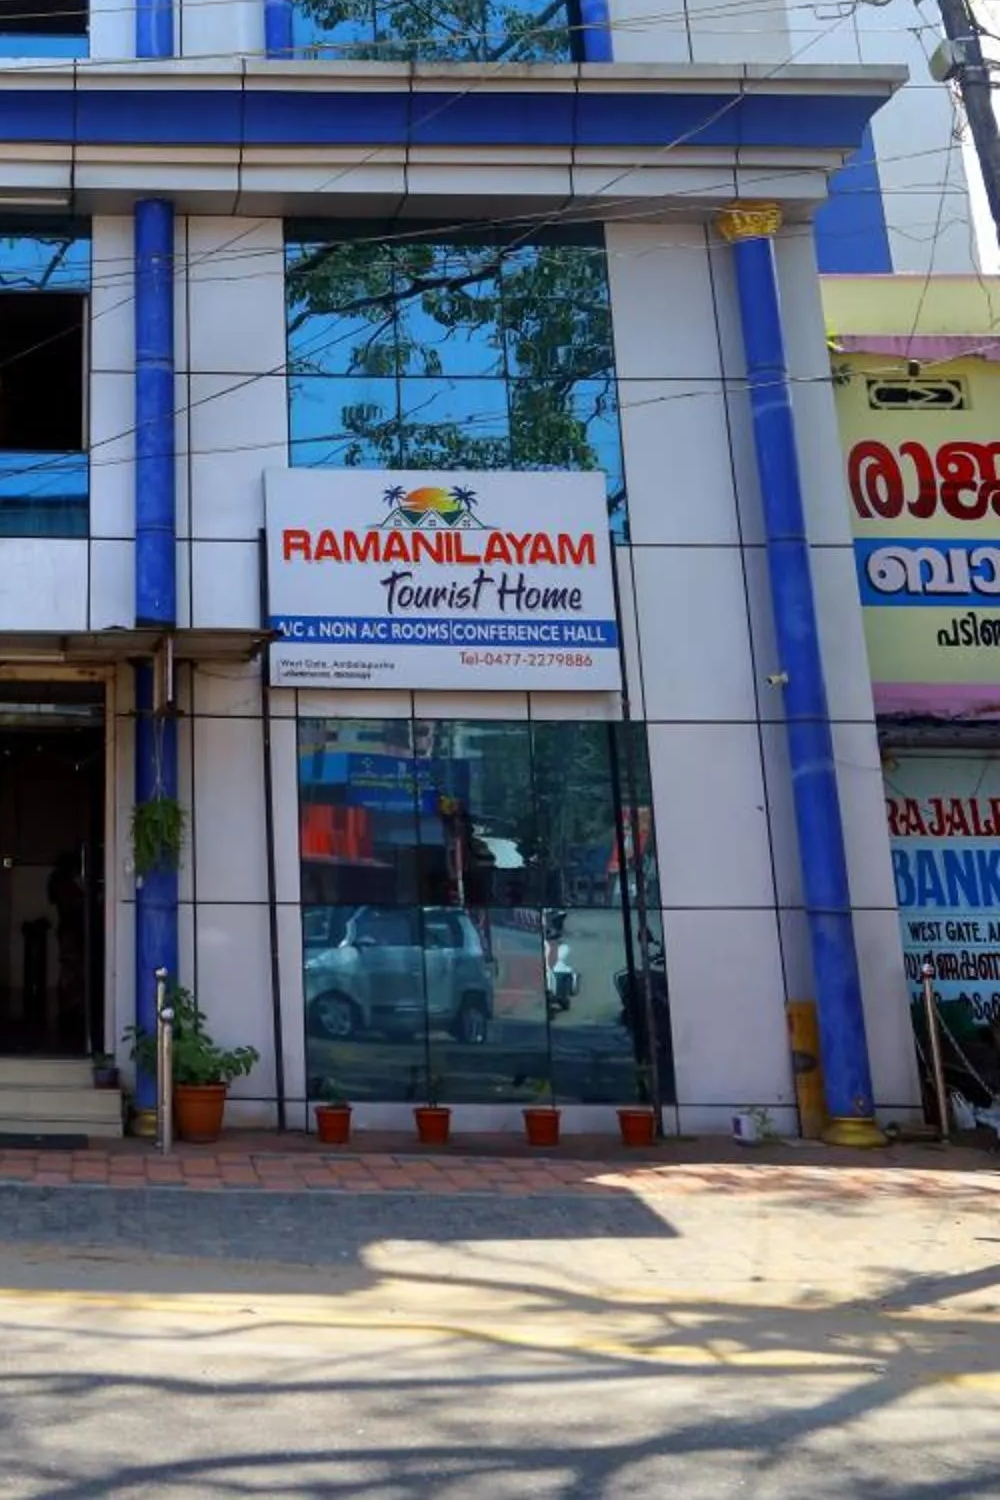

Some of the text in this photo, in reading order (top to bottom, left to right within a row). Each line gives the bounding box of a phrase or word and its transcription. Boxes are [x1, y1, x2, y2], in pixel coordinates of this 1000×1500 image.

[282, 529, 596, 565] RAMANILAYAM
[380, 568, 583, 614] Tourist Home
[320, 622, 357, 639] NON
[360, 623, 388, 640] A/C
[391, 623, 449, 641] ROOMS
[452, 624, 560, 642] CONFERENCE
[564, 625, 607, 642] HALL
[908, 921, 941, 941] WEST
